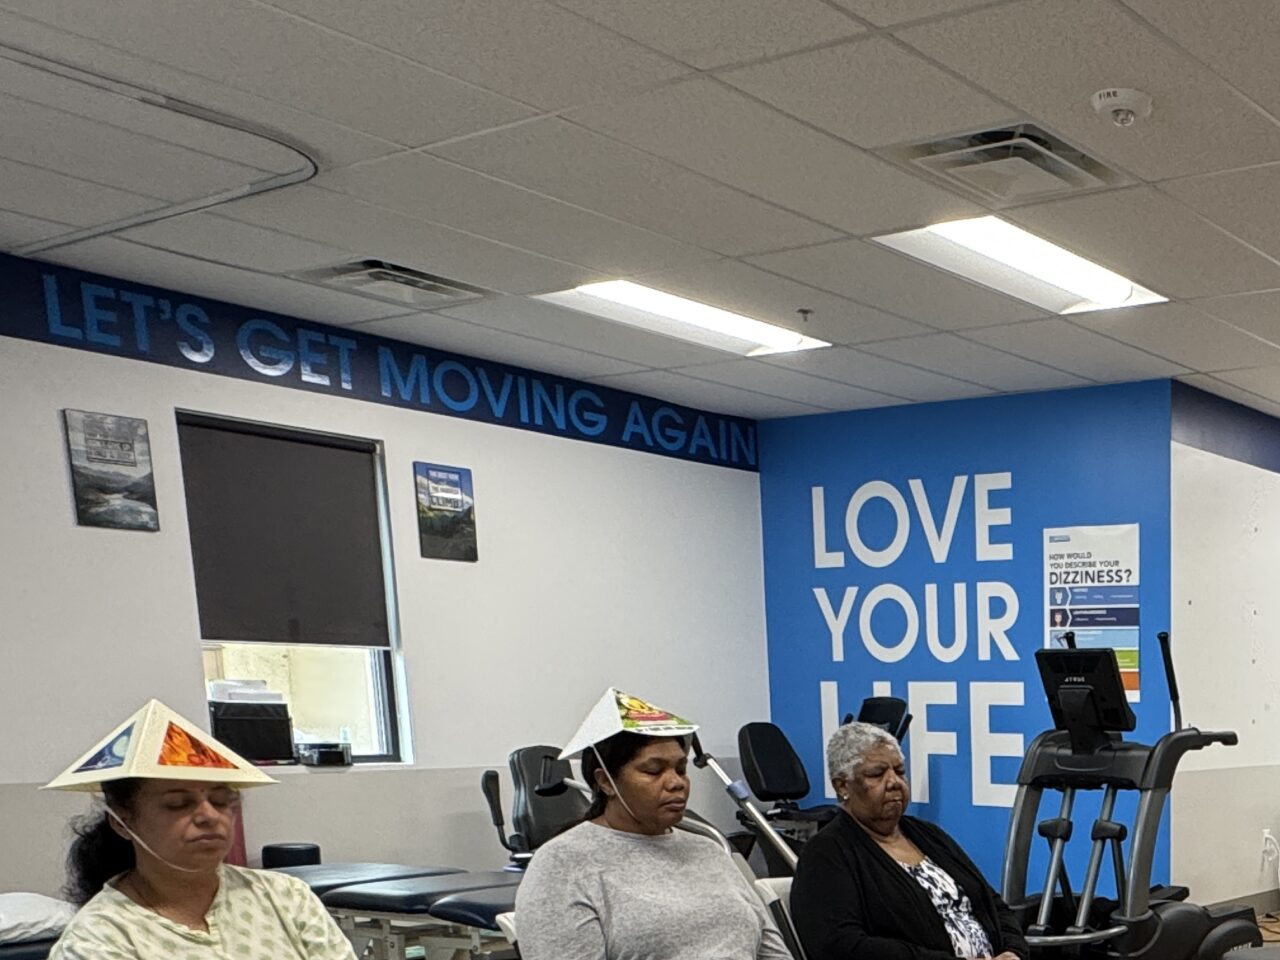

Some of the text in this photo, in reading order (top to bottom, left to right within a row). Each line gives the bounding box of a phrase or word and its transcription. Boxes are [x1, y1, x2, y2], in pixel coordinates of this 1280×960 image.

[1098, 91, 1118, 99] FIRE
[42, 275, 758, 466] LET'S GET MOVING AGAIN
[812, 471, 1013, 568] LOVE
[1049, 553, 1065, 561] HOW
[1049, 569, 1132, 585] DIZZINESS?
[1065, 561, 1097, 569] DESCRIBE
[1099, 560, 1119, 568] YOUR
[813, 580, 1021, 664] YOUR
[819, 681, 1025, 807] LFE
